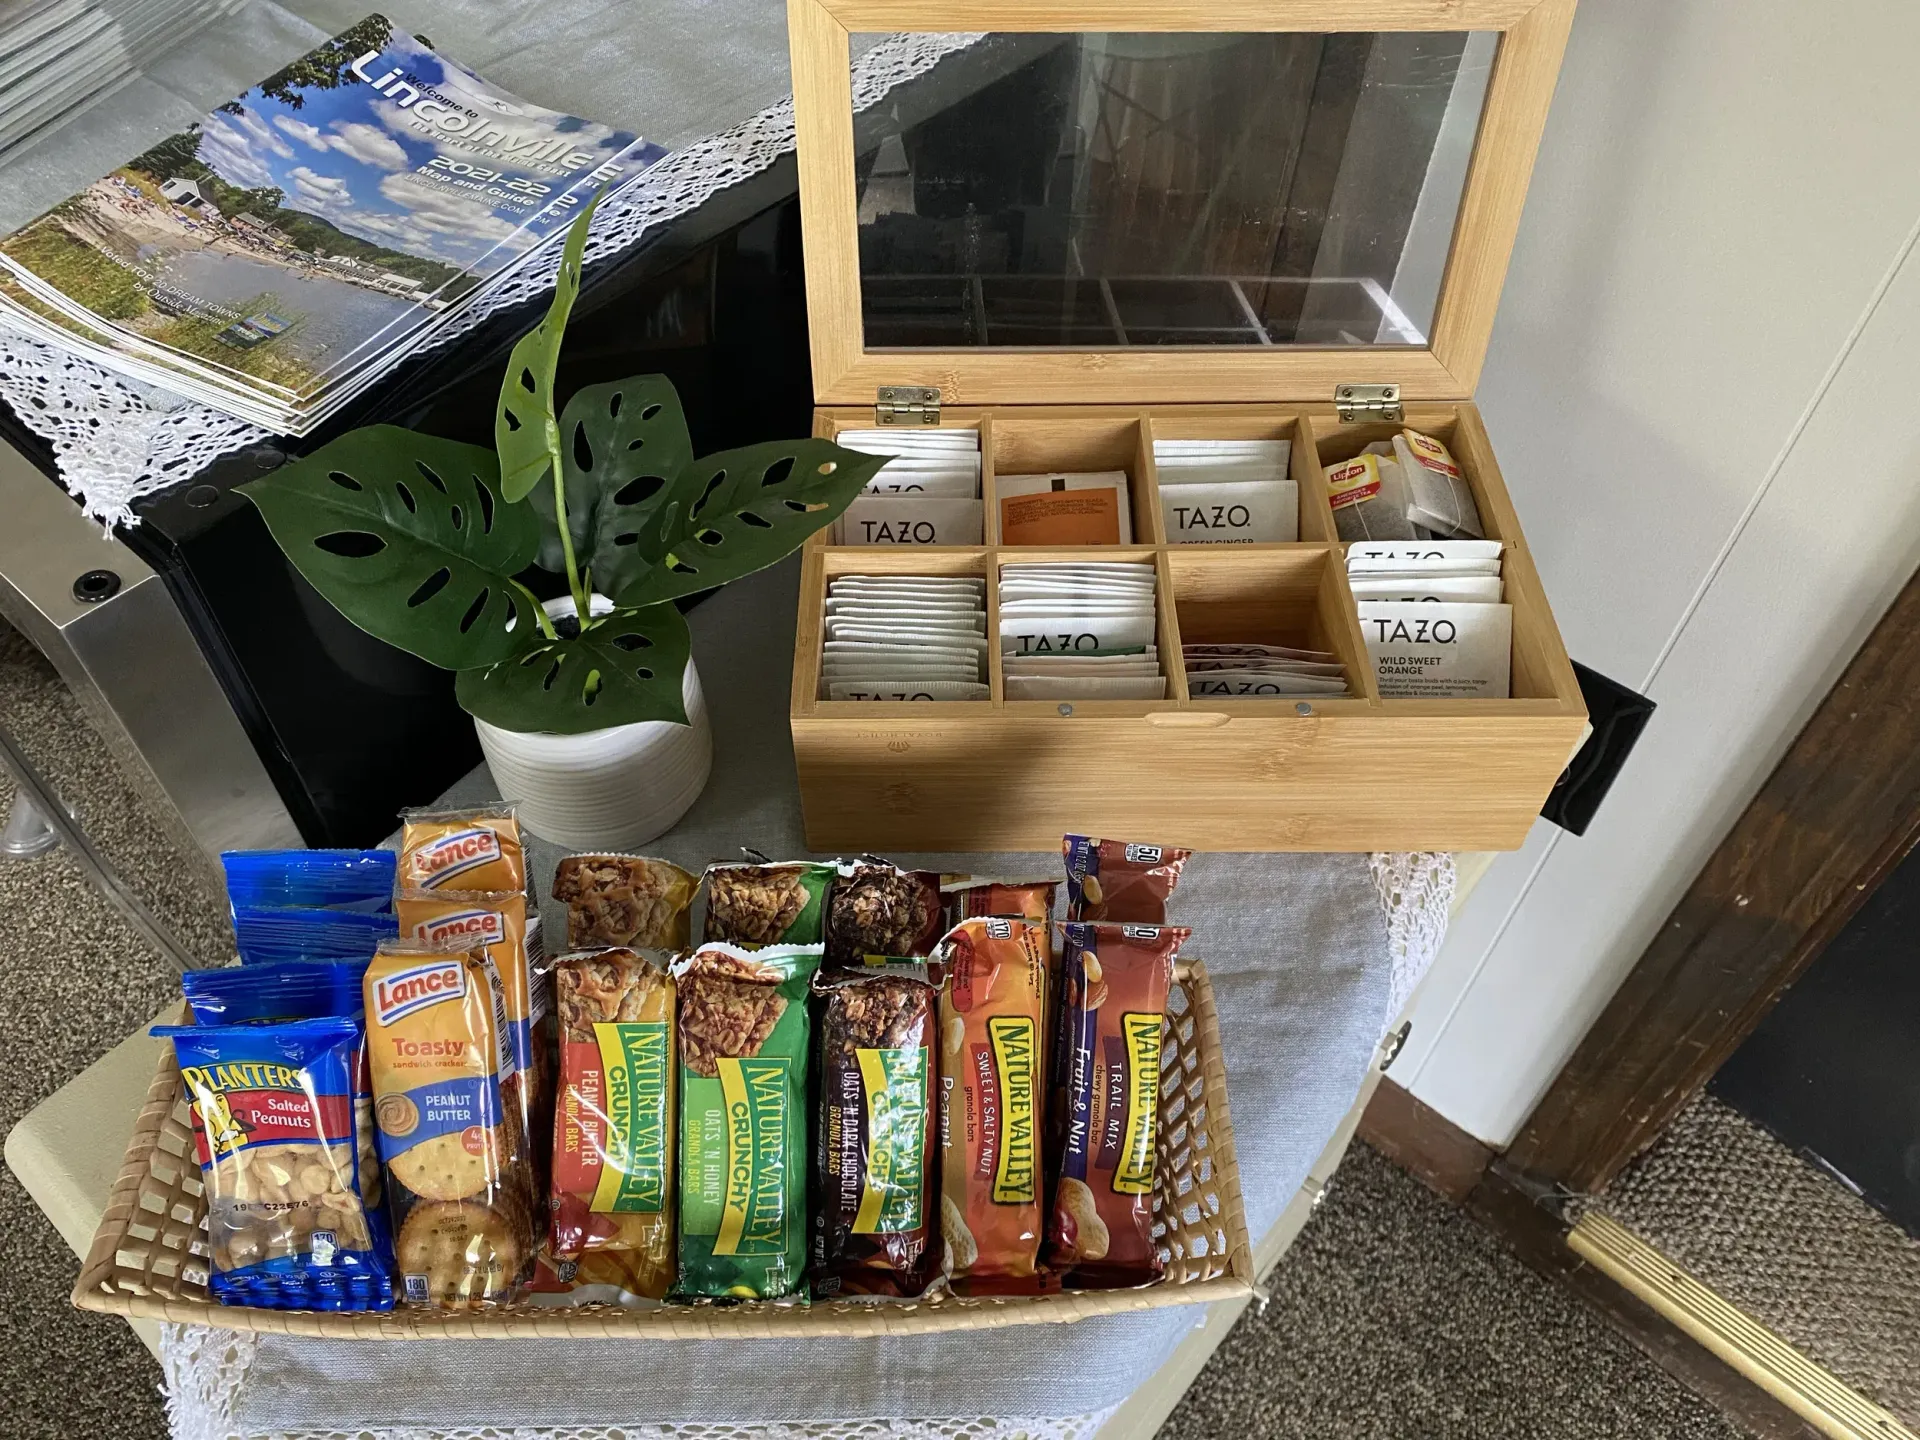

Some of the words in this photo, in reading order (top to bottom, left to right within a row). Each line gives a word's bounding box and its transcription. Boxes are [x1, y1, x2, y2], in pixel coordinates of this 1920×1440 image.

[351, 50, 595, 171] Lincolnville
[405, 73, 463, 111] Welcome
[464, 107, 479, 119] to
[409, 120, 427, 133] The
[429, 129, 462, 148] Heart
[463, 141, 480, 154] of
[481, 147, 499, 160] the
[501, 154, 536, 170] Maine
[537, 163, 571, 178] Coast
[404, 174, 526, 215] LINCOLNVILLEMAINE.COM
[416, 165, 452, 185] Map
[454, 176, 487, 193] and
[488, 187, 535, 206] Guide
[427, 155, 552, 198] 2021-22
[100, 246, 131, 270] Voted
[131, 265, 155, 283] TOP
[153, 279, 168, 290] 20
[166, 285, 206, 307] DREAM
[205, 301, 242, 320] TOWNS
[132, 282, 149, 293] by
[146, 288, 185, 312] Outside
[1379, 656, 1406, 666] WILD
[1408, 656, 1442, 666] SWEET
[1379, 666, 1423, 676] ORANGE
[415, 834, 493, 873] Lance
[417, 915, 498, 944] Lance
[995, 921, 1010, 938] 170
[378, 969, 459, 1012] Lance
[391, 1038, 465, 1057] Toasty
[392, 1061, 432, 1069] sandwich
[1130, 1020, 1161, 1107] NATURE
[181, 1064, 304, 1098] PLANTERS
[624, 1031, 665, 1121] NATURE
[842, 1071, 860, 1099] OATS
[977, 1051, 995, 1094] SWEET
[996, 1025, 1031, 1113] NATURE
[1074, 1047, 1091, 1094] Fruit
[1094, 1064, 1106, 1093] chewy
[1110, 1062, 1123, 1111] TRAIL
[268, 1098, 310, 1113] Salted
[426, 1095, 471, 1107] PEANUT
[565, 1084, 579, 1125] GRANOLA
[582, 1070, 599, 1117] PEANUT
[842, 1103, 859, 1115] 'N
[940, 1077, 954, 1149] Peanut
[964, 1086, 977, 1121] granola
[1073, 1099, 1087, 1113] &
[1091, 1093, 1103, 1132] granola
[251, 1110, 312, 1128] Peanuts
[426, 1110, 471, 1121] BUTTER
[704, 1110, 721, 1141] OATS
[747, 1067, 784, 1160] NATURE
[829, 1105, 841, 1148] GRANOLA
[842, 1117, 859, 1149] DARK
[967, 1123, 978, 1143] bars
[982, 1106, 996, 1146] SALTY
[565, 1127, 579, 1153] BARS
[582, 1121, 599, 1166] BUTTER
[687, 1120, 701, 1165] GRANOLA
[704, 1145, 720, 1160] 'N
[871, 1091, 892, 1188] CRNCH
[1069, 1119, 1086, 1155] Nut
[1090, 1131, 1099, 1145] bar
[1105, 1119, 1121, 1150] MIX
[1119, 1111, 1157, 1189] VALLEY
[621, 1124, 662, 1206] VALLEY
[730, 1101, 752, 1213] CRUNCHY
[827, 1150, 840, 1176] BARS
[979, 1149, 993, 1175] NUT
[999, 1117, 1032, 1197] VALLEY
[687, 1168, 700, 1194] BARS
[704, 1164, 720, 1206] HONEY
[841, 1152, 858, 1212] CHOCOLATE
[264, 1200, 309, 1211] C22E76
[745, 1163, 783, 1246] VALLEY
[408, 1279, 425, 1289] 180
